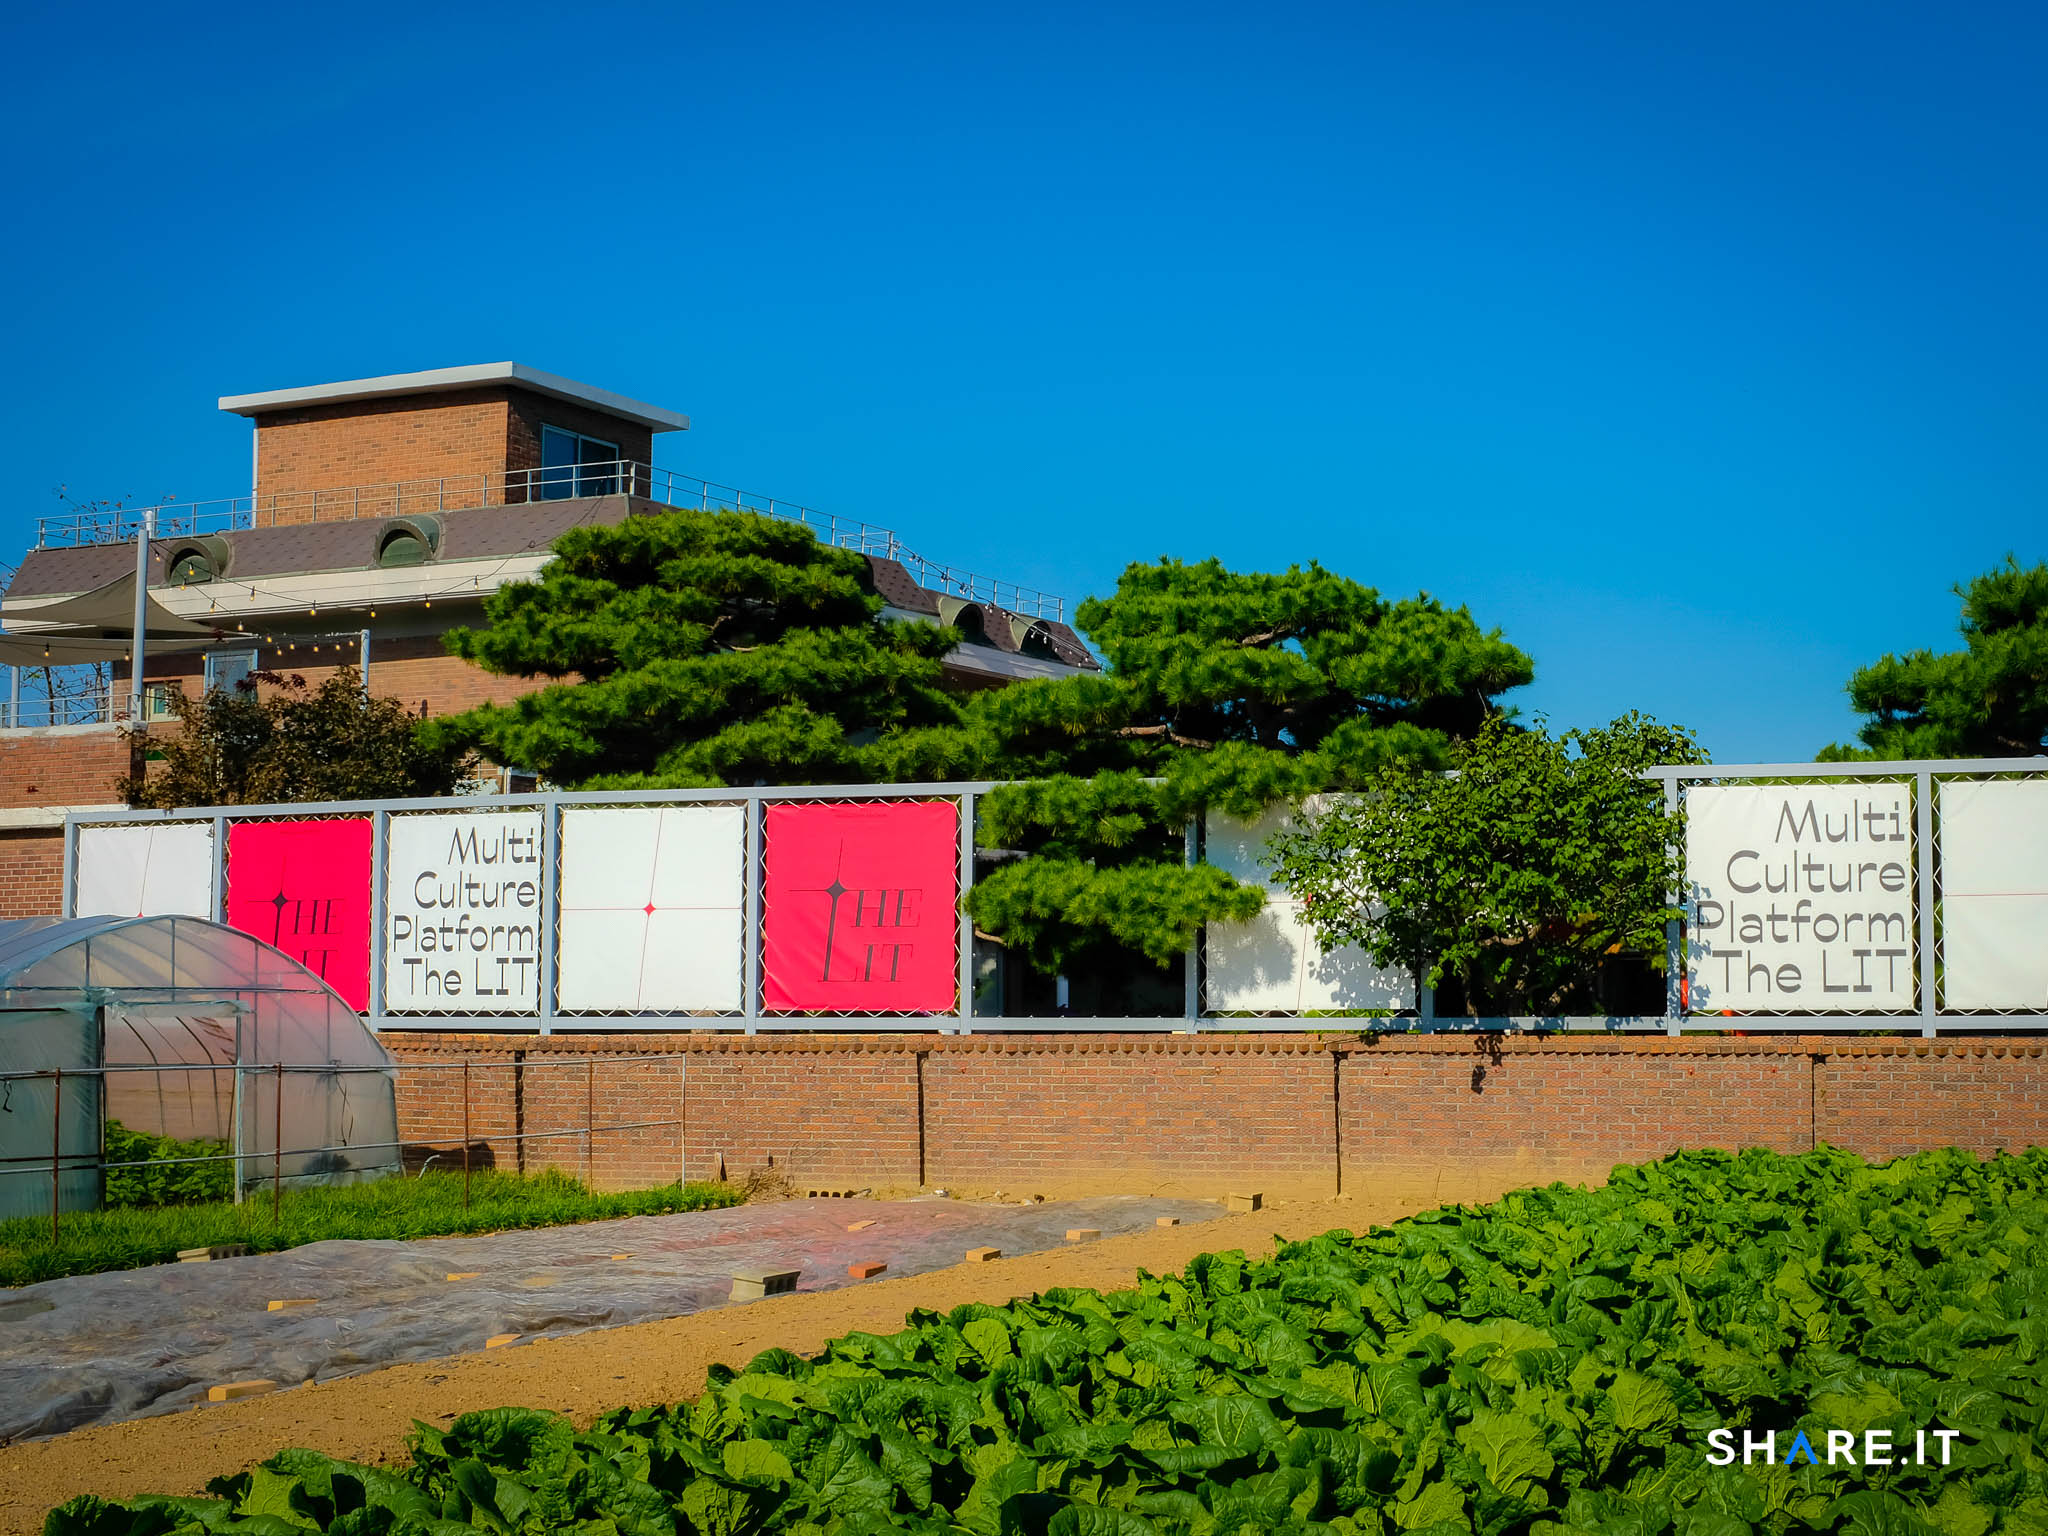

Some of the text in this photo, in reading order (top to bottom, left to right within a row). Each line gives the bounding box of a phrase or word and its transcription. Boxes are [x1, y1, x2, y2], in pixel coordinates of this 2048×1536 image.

[1775, 799, 1905, 843] Multi
[447, 825, 536, 865] Multi
[414, 870, 536, 909] Culture
[1726, 850, 1906, 894] Culture
[393, 913, 535, 953] Platform
[1696, 899, 1905, 943] Platform
[402, 957, 534, 996] The LIT
[1712, 949, 1907, 993] The LIT
